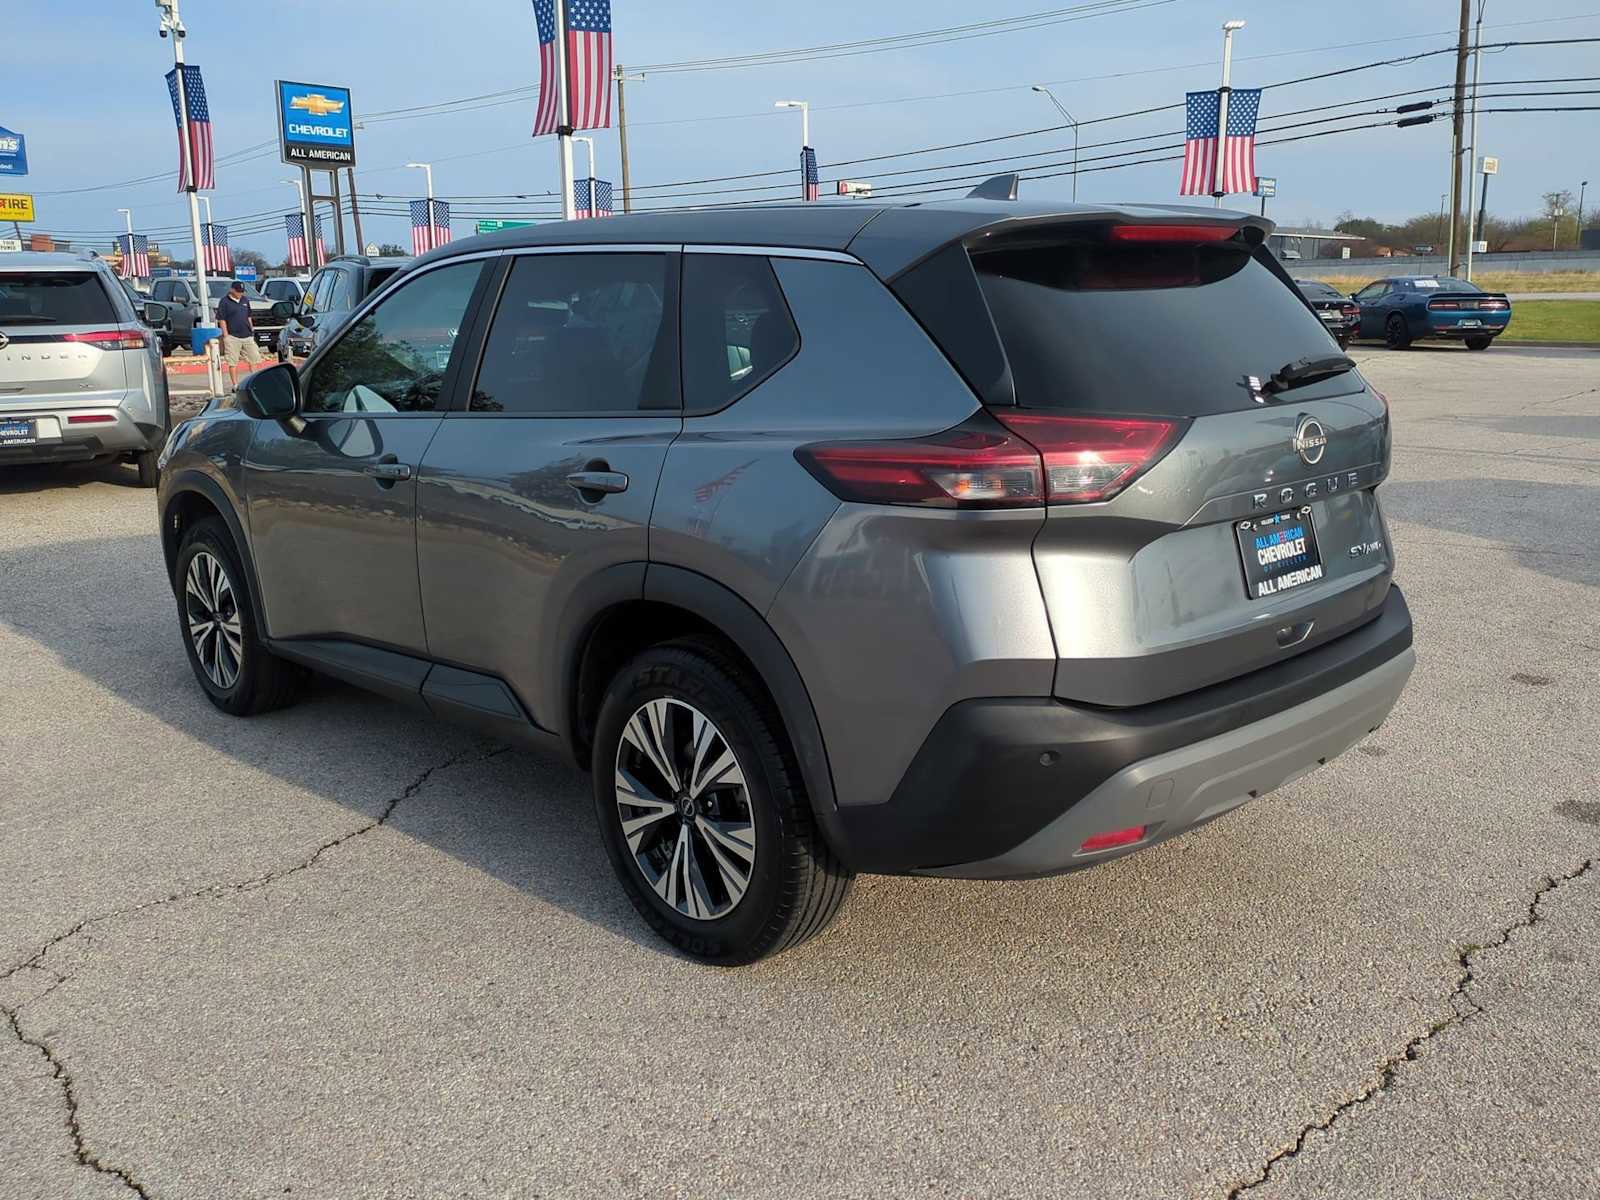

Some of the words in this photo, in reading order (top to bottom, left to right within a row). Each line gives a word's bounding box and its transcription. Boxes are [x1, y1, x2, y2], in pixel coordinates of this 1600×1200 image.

[288, 123, 349, 138] CHEVROLET
[290, 147, 307, 158] ALL
[308, 149, 351, 160] AMERICAN
[1295, 436, 1328, 450] NISSAN
[1252, 472, 1358, 510] ROGUE
[1255, 535, 1269, 549] ALL
[1269, 527, 1303, 545] AMERICAN
[1257, 537, 1307, 566] CHEVROLET
[1258, 579, 1278, 597] ALL
[1278, 564, 1323, 591] AMERICAN
